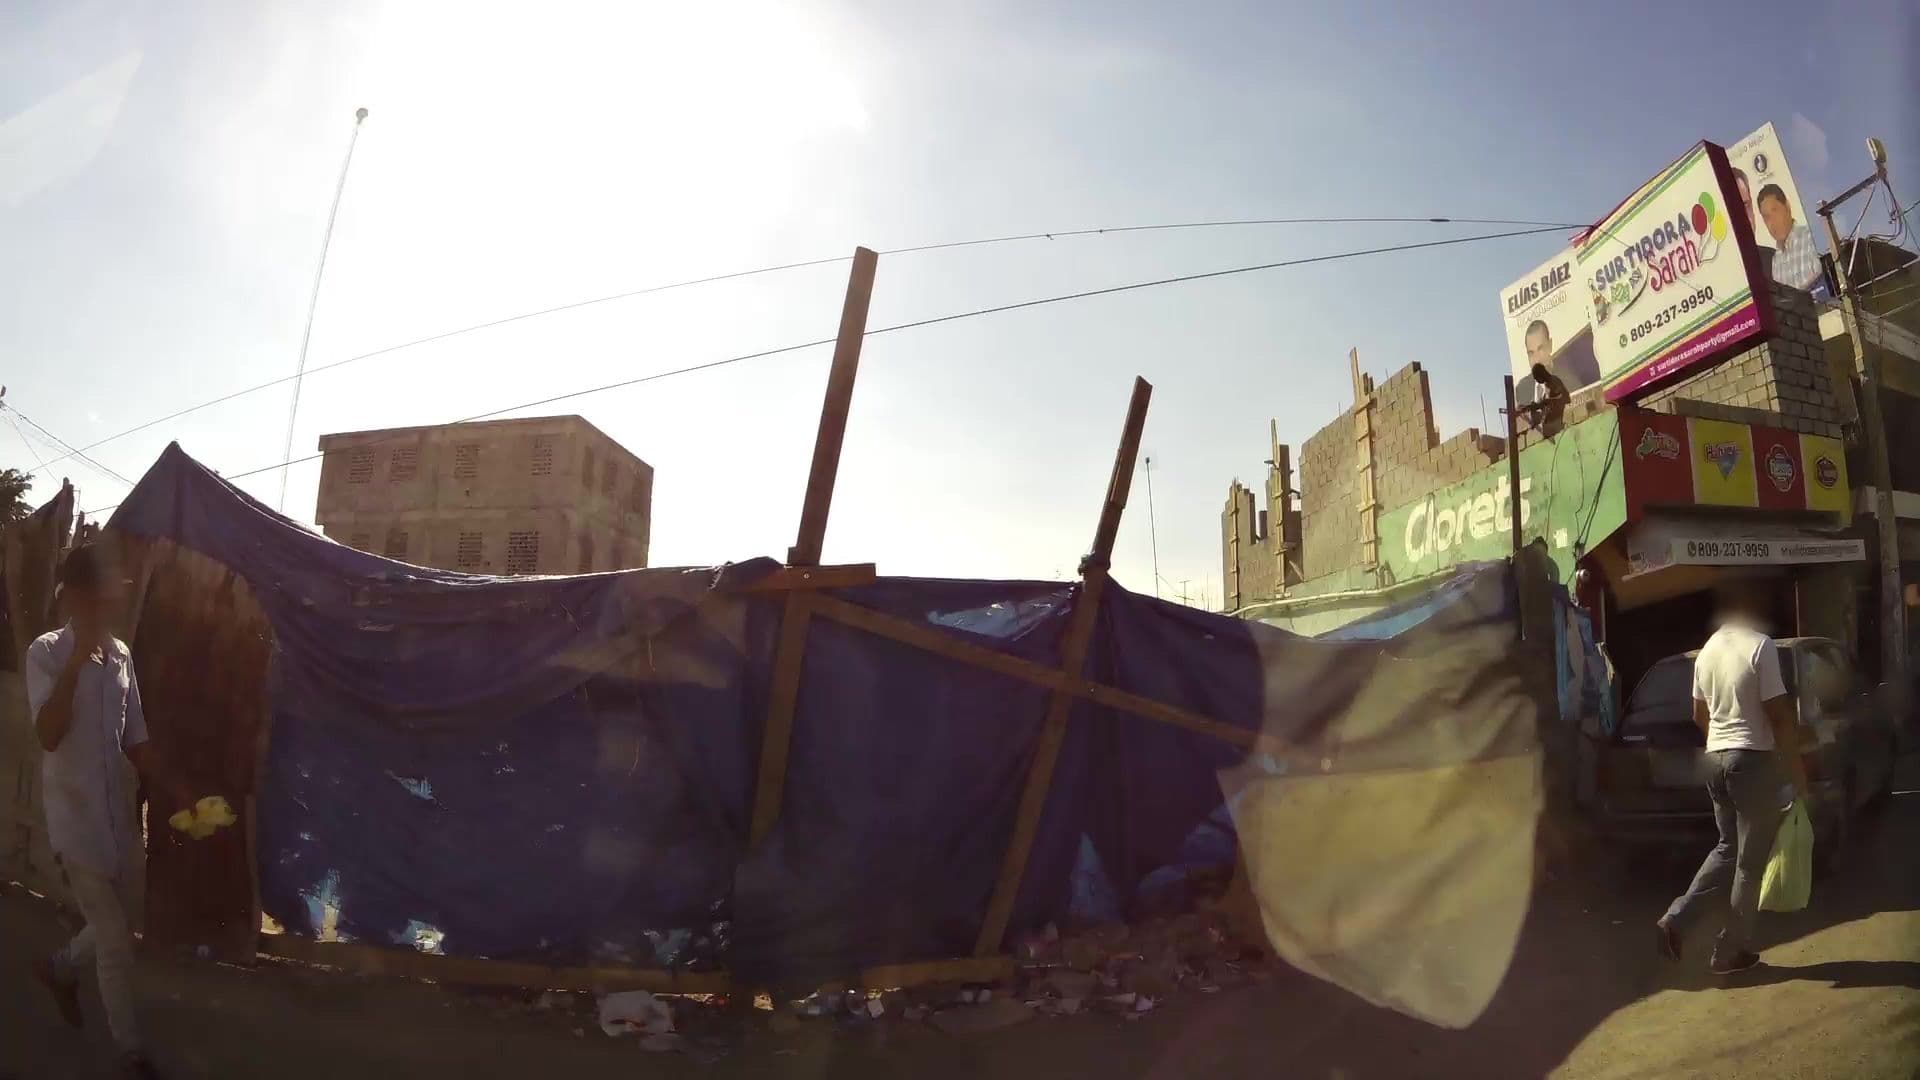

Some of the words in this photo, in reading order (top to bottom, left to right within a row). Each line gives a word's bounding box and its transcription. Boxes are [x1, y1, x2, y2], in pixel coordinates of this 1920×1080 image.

[1595, 212, 1691, 291] SURTIDORA
[1645, 229, 1700, 292] Sarah
[1507, 281, 1539, 314] ELÍAS
[1541, 261, 1571, 293] BÁEZ
[1630, 286, 1713, 341] 809-237-9950
